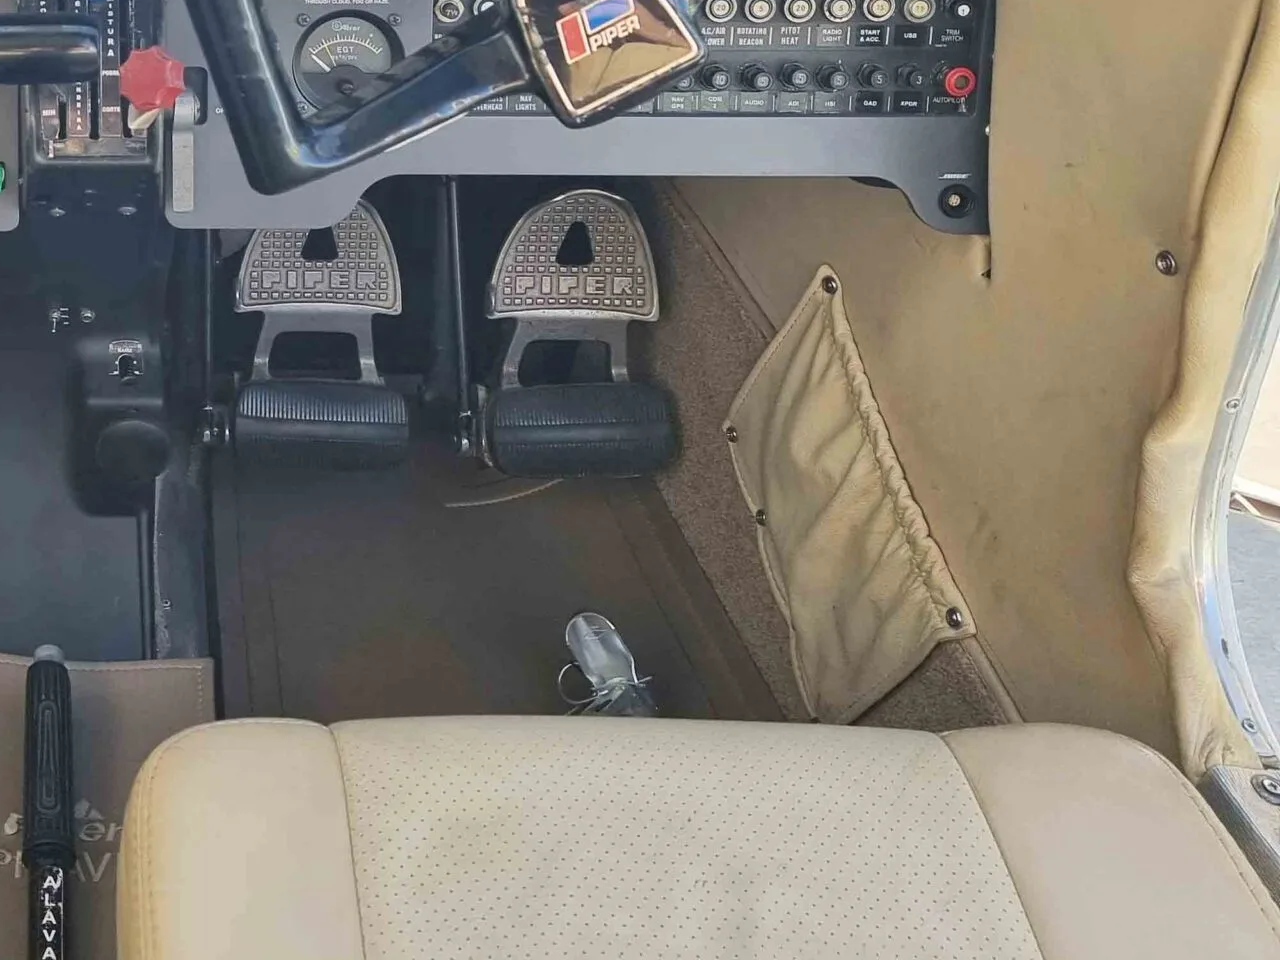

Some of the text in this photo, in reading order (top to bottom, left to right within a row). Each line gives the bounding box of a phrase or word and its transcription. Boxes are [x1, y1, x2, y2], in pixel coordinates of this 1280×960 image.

[589, 15, 640, 52] PIPER
[781, 37, 798, 45] HEAT
[261, 271, 377, 291] PIPER
[516, 276, 634, 295] PIPER
